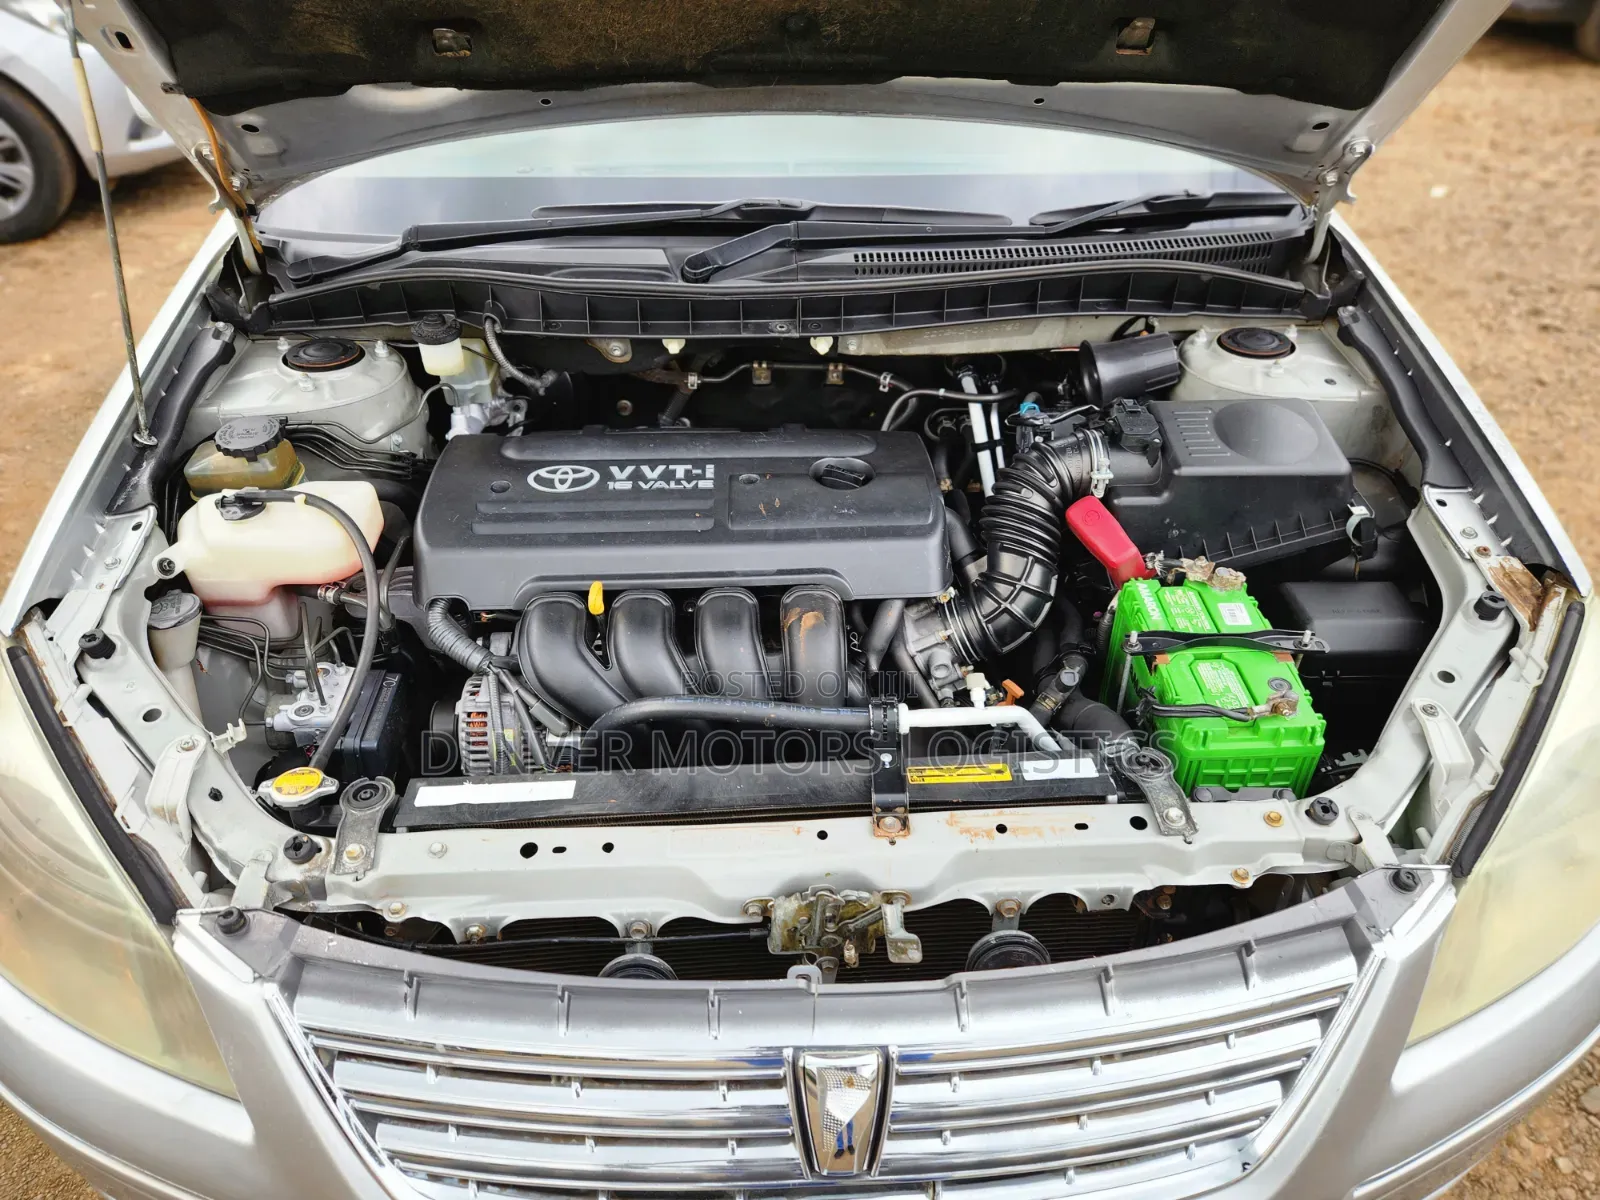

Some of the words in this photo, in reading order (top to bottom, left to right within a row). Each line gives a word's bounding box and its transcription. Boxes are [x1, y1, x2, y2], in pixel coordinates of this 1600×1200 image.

[609, 464, 715, 480] VVT-i
[607, 481, 633, 490] 16
[637, 480, 714, 490] VALVE
[1136, 582, 1163, 620] AMARON
